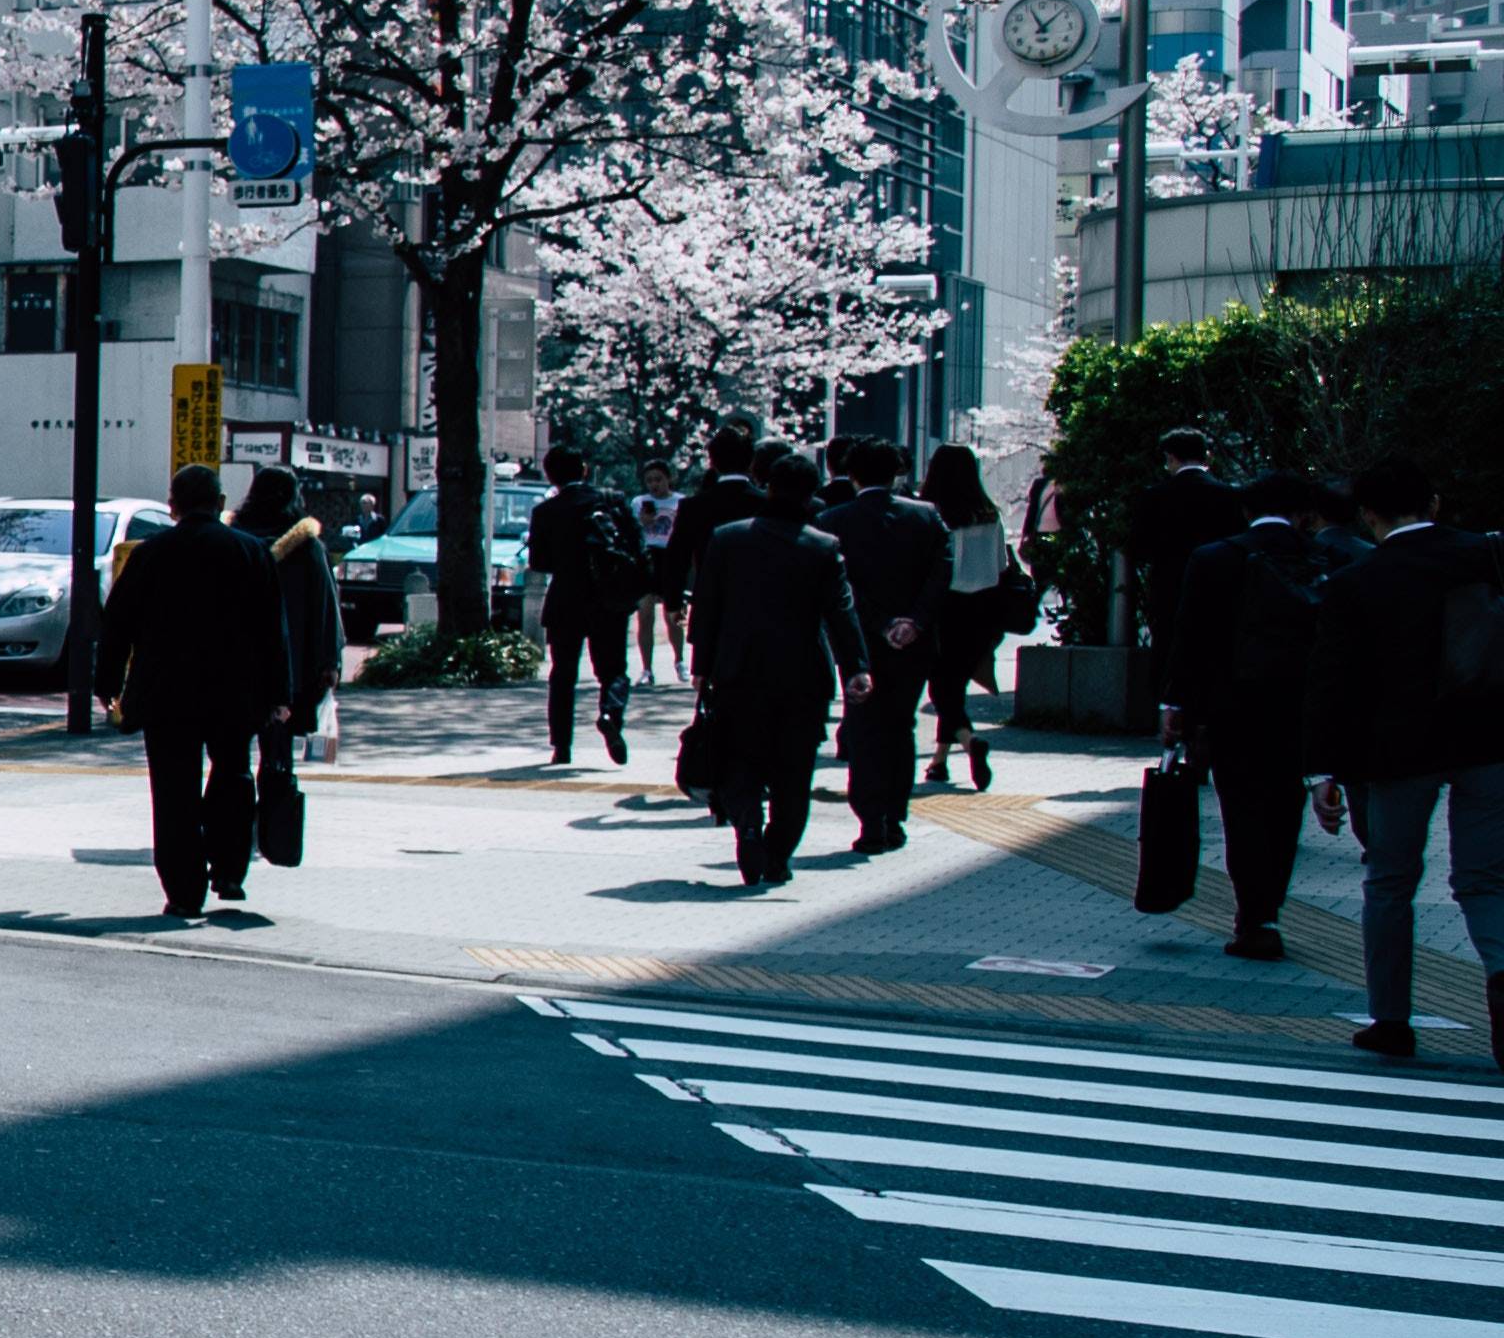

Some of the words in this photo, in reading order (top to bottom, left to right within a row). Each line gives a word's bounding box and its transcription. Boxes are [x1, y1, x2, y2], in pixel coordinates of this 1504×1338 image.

[234, 184, 290, 200] 歩行者優先
